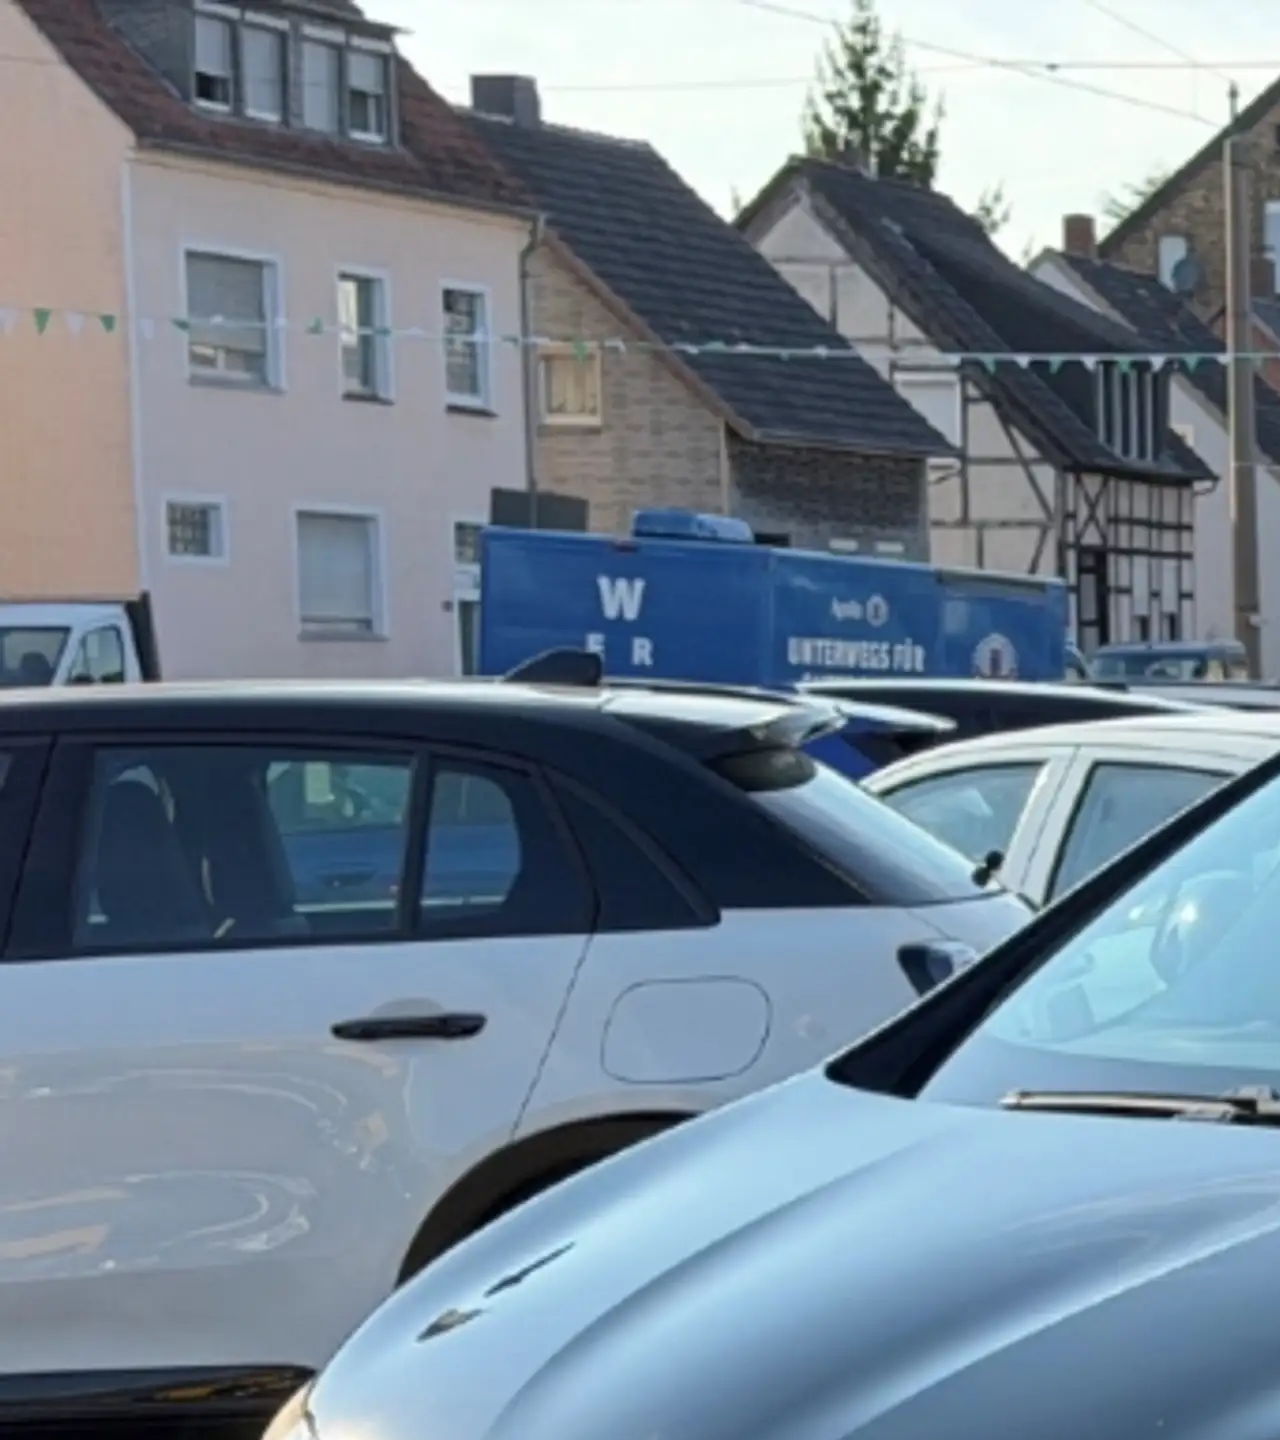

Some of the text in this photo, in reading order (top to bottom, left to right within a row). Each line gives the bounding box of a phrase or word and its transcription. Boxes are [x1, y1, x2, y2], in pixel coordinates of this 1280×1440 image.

[596, 574, 645, 621] W
[632, 636, 653, 667] R
[787, 636, 890, 670] UNTERWEGS
